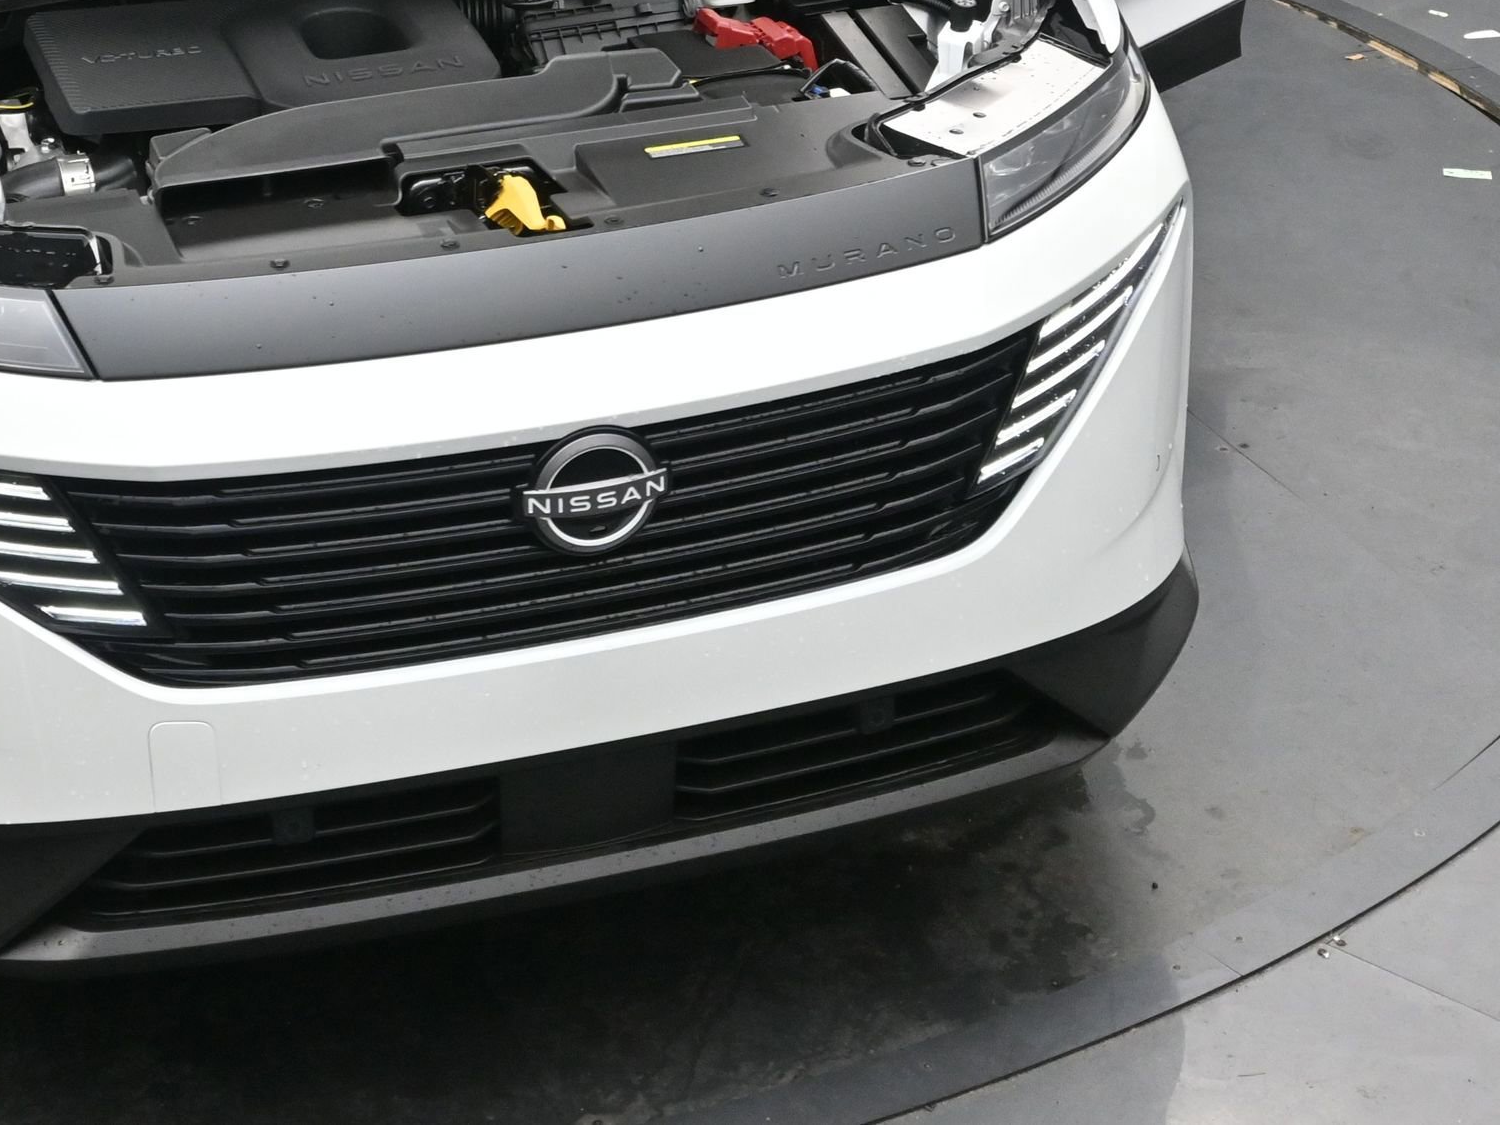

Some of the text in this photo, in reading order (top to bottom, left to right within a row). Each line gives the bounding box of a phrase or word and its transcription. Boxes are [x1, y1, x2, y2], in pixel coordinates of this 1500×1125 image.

[302, 55, 465, 88] NISSAN
[776, 225, 957, 280] MURANO
[526, 475, 668, 516] NISSAN
